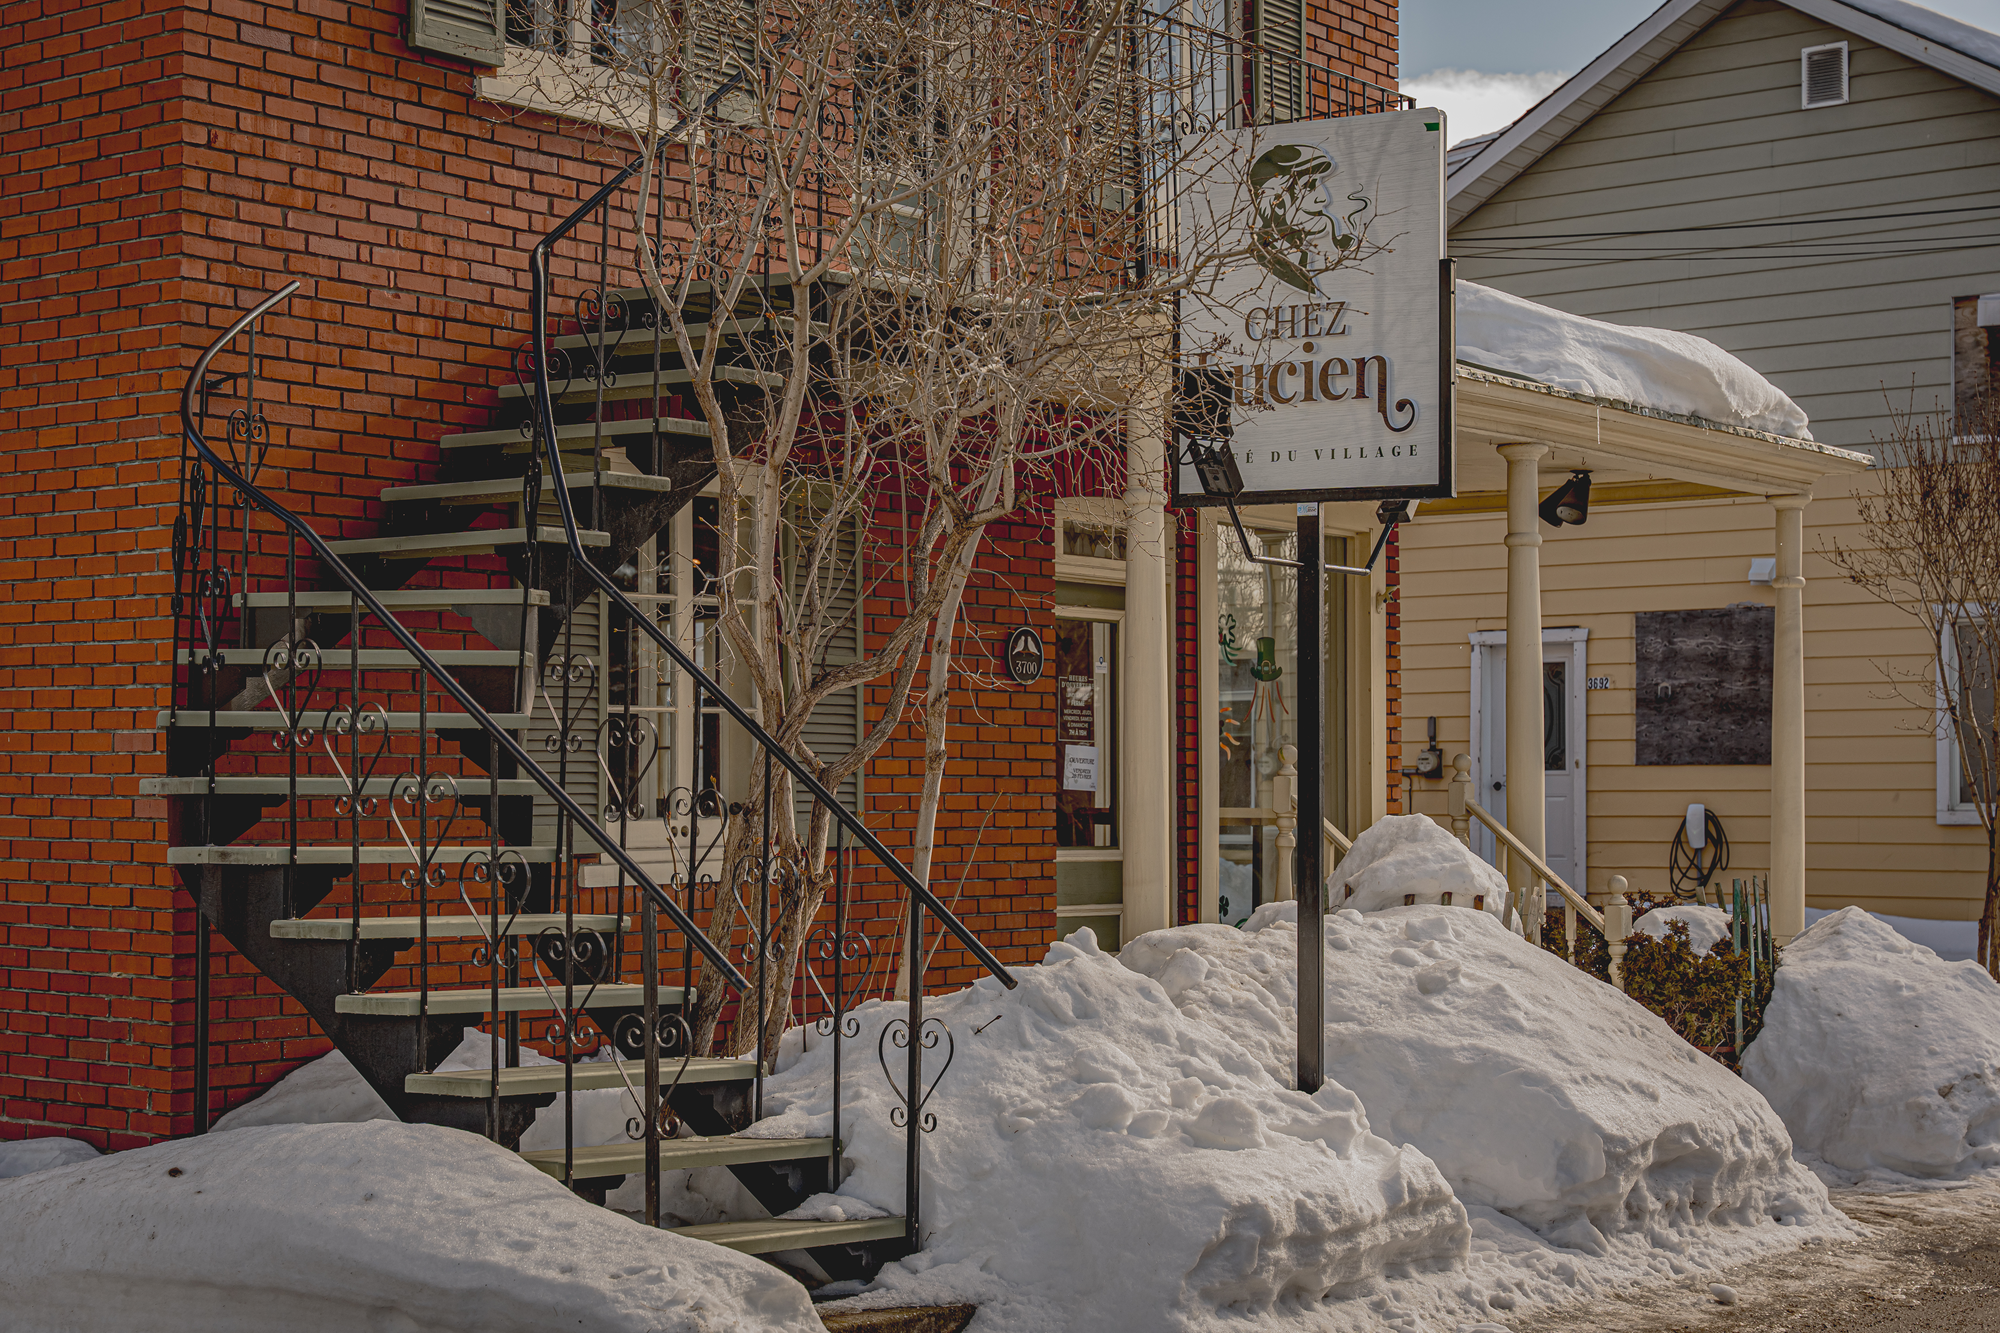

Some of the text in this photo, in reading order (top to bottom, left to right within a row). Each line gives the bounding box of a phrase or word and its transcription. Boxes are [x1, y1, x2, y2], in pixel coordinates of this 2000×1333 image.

[1244, 300, 1347, 342] CHEZ
[1197, 341, 1415, 433] ucien
[1270, 450, 1298, 463] DU
[1314, 444, 1418, 461] VILLAGE
[1016, 660, 1037, 674] 3700
[1588, 677, 1609, 689] 3692
